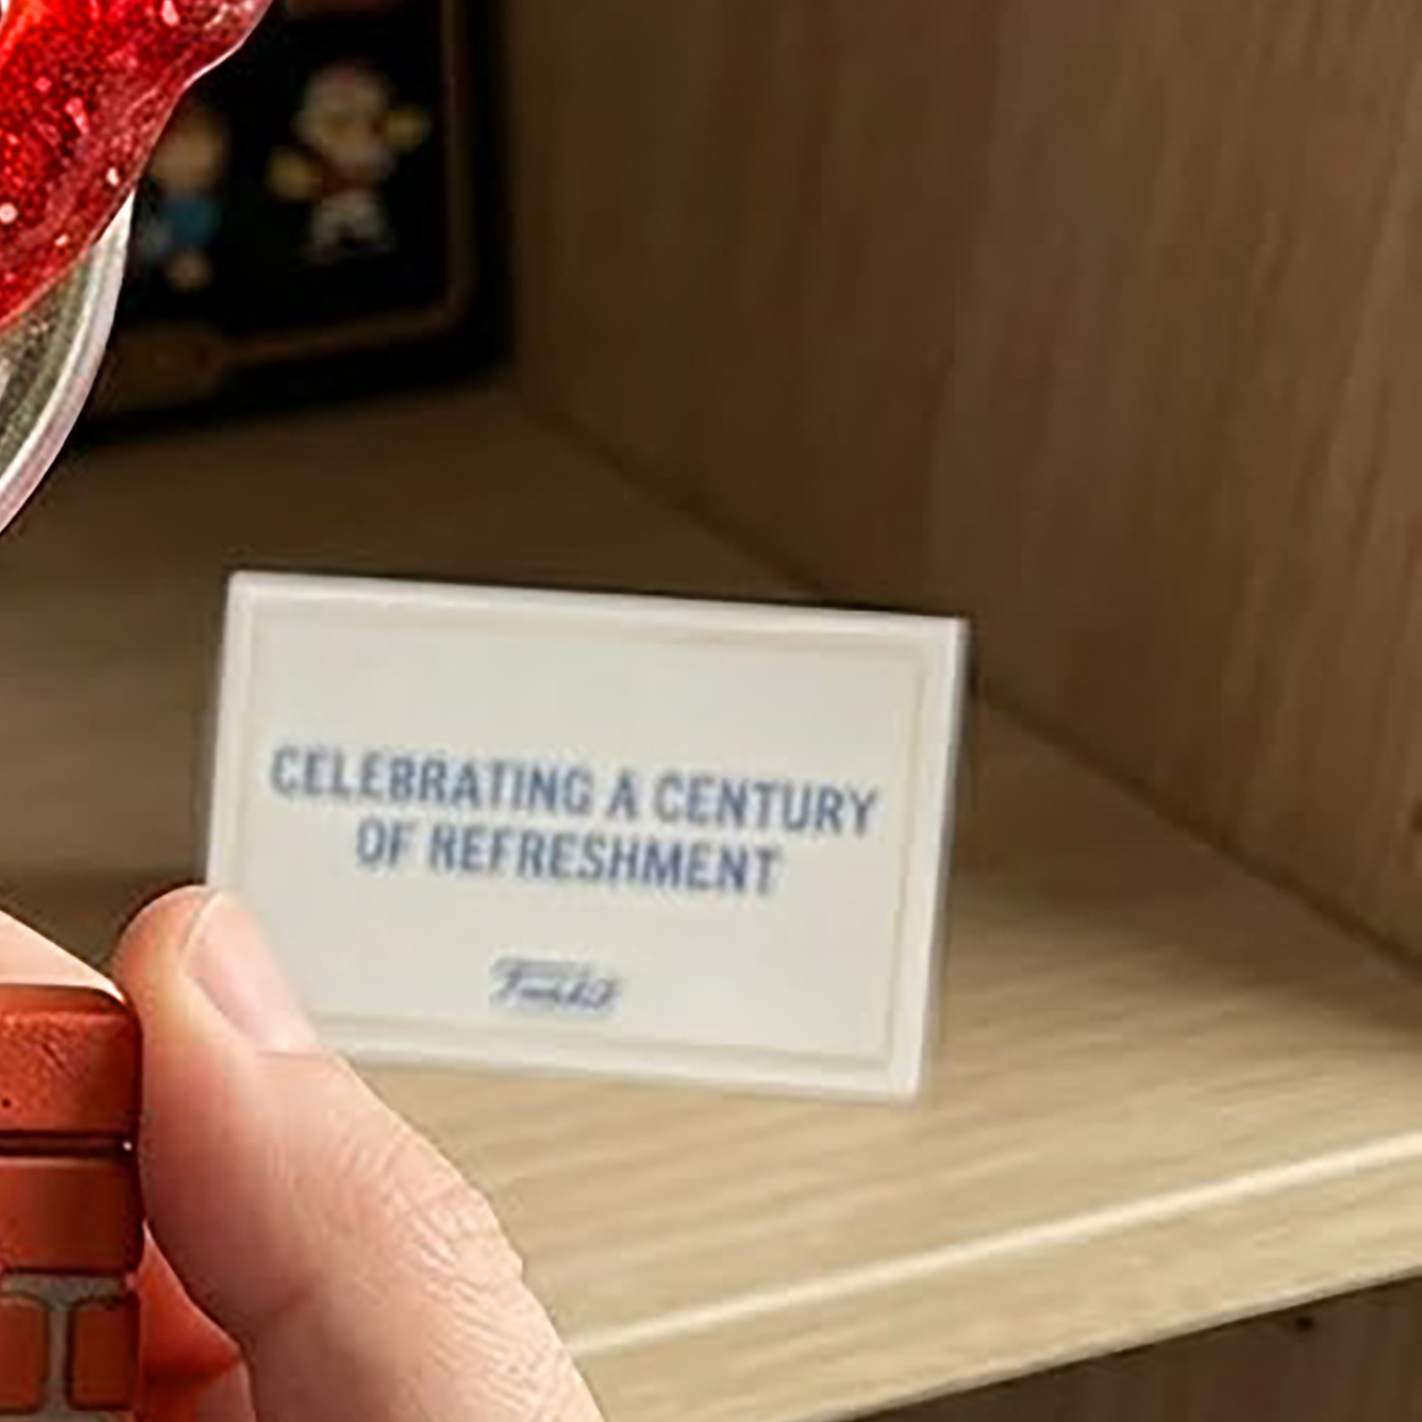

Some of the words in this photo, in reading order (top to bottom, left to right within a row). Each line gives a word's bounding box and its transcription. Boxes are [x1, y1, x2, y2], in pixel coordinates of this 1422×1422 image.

[269, 743, 595, 817] CELEBRATING
[607, 769, 638, 820] A
[654, 771, 878, 835] CENTURY
[356, 815, 417, 870] OF
[428, 820, 784, 897] REFRESHMENT
